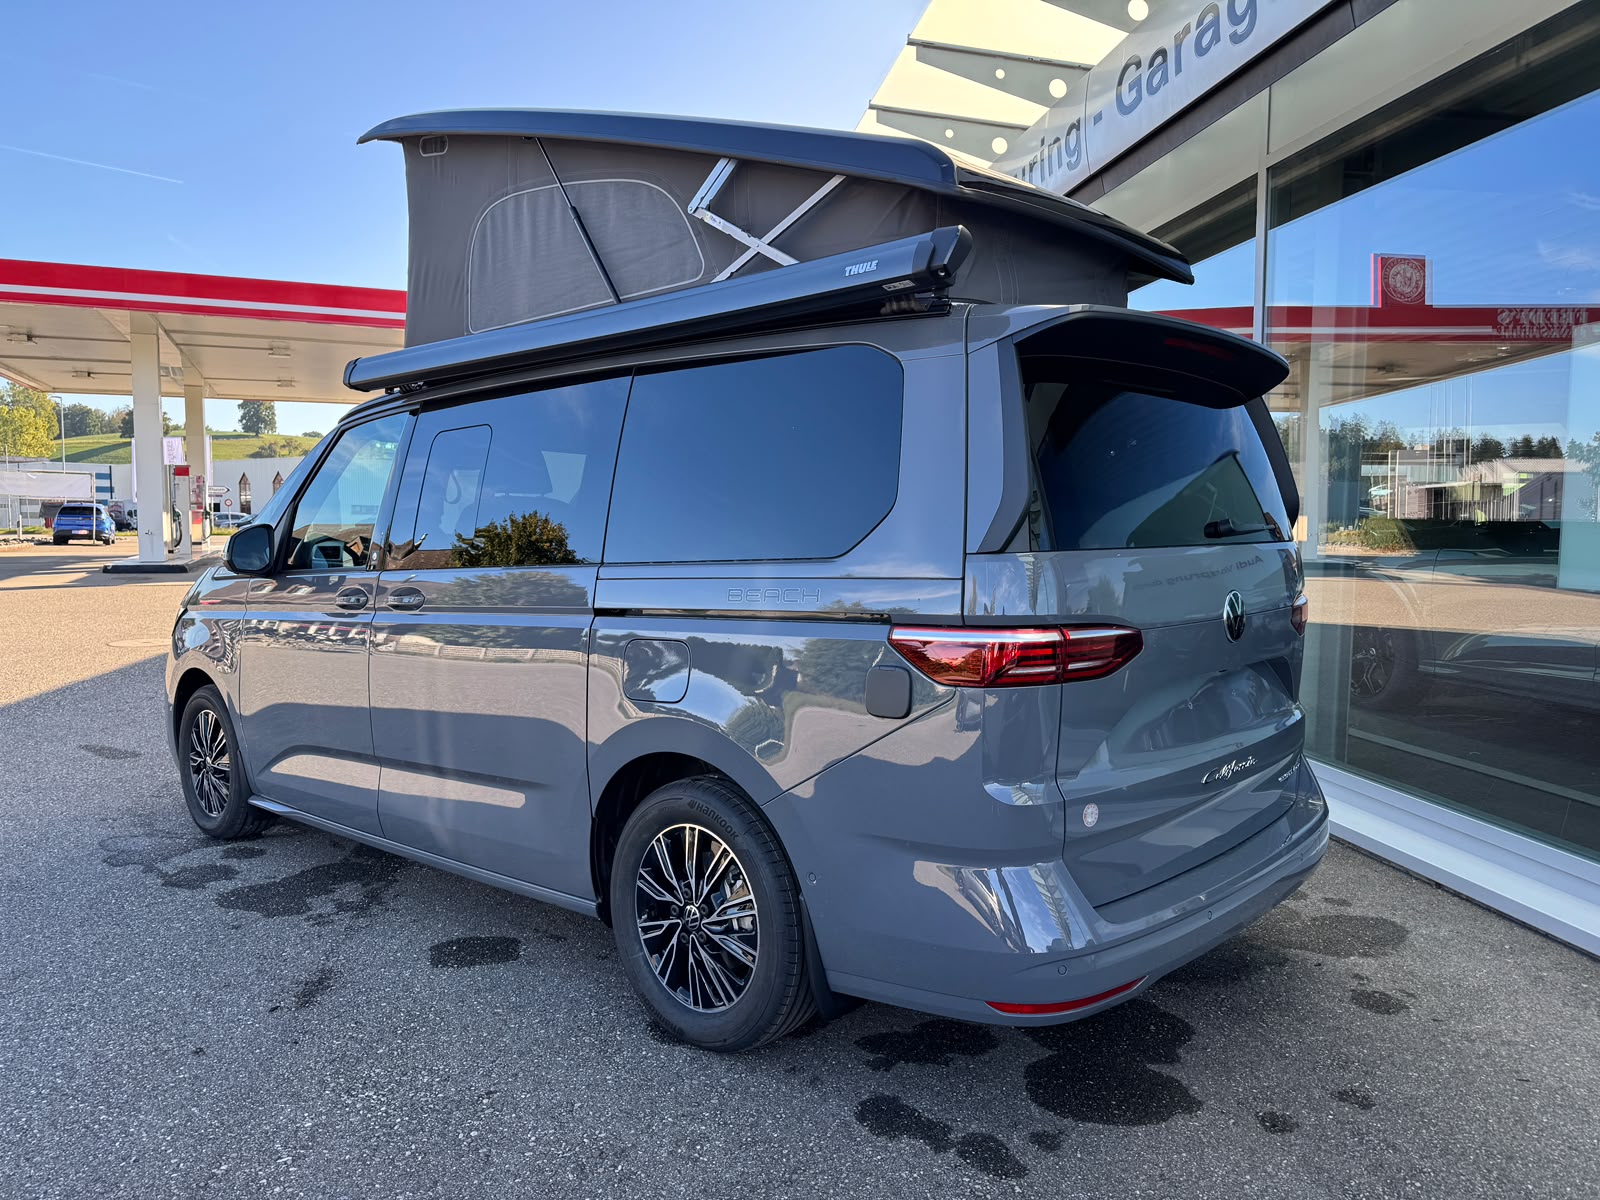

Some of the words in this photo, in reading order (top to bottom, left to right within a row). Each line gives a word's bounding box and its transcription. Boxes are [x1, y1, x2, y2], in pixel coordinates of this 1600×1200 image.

[1115, 0, 1258, 116] Garag
[844, 260, 879, 277] THULE
[727, 587, 821, 604] BEACH
